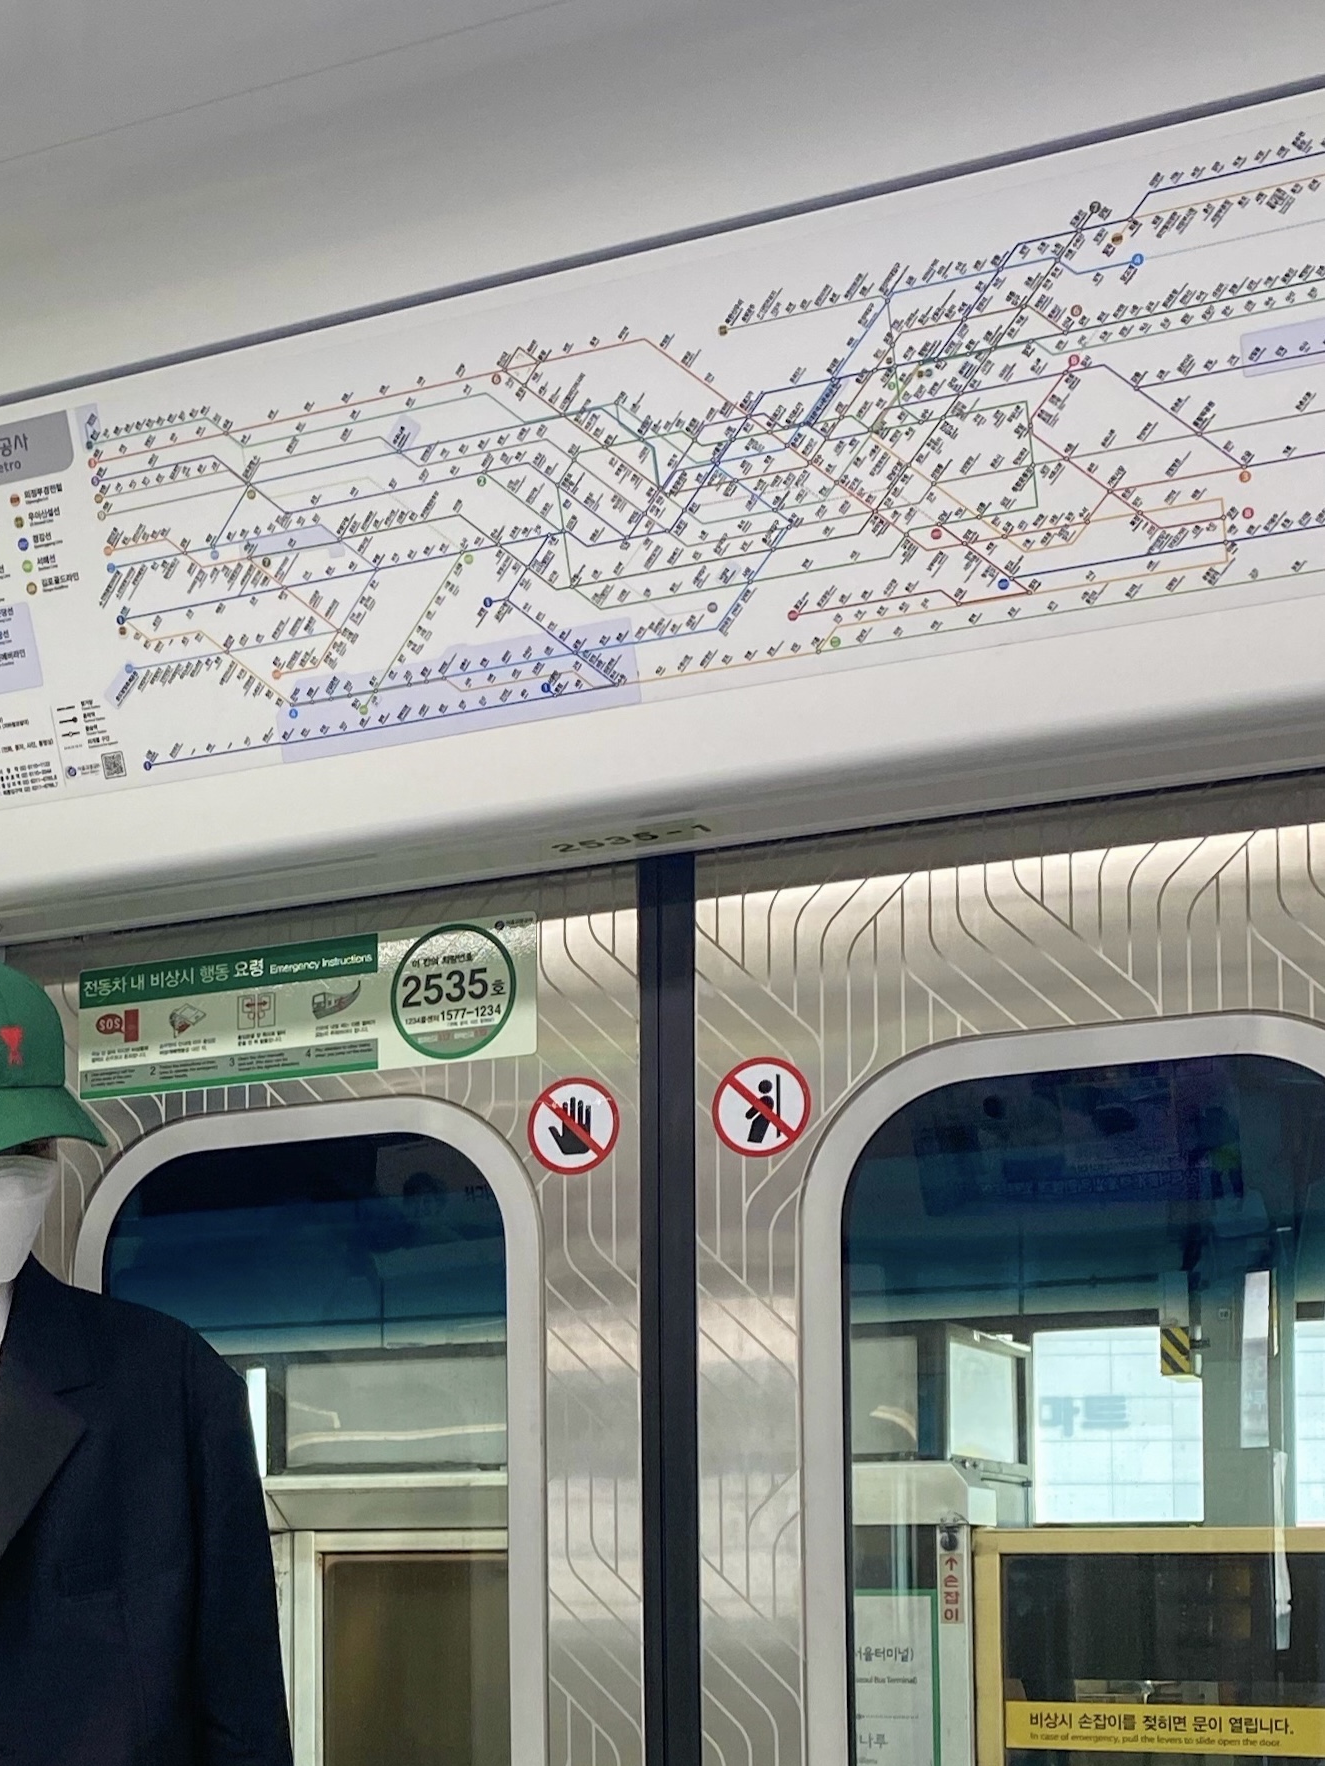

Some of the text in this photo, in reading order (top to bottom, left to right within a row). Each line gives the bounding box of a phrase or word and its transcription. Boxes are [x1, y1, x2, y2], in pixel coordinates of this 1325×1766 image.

[270, 953, 373, 975] Emergency Instructions
[83, 958, 264, 997] 전동차 내 비상시 행동 요령
[440, 1004, 502, 1021] 1577-1234
[98, 1018, 121, 1031] SOS
[150, 1066, 156, 1076] 2
[944, 1575, 959, 1621] 손잡이
[1029, 1712, 1294, 1735] 비상시 손잡이를 젖히면 문이 열립니다.
[1060, 1732, 1069, 1740] of
[1122, 1734, 1139, 1743] pull
[1140, 1735, 1155, 1743] the
[1217, 1738, 1240, 1747] open
[1242, 1737, 1257, 1746] the
